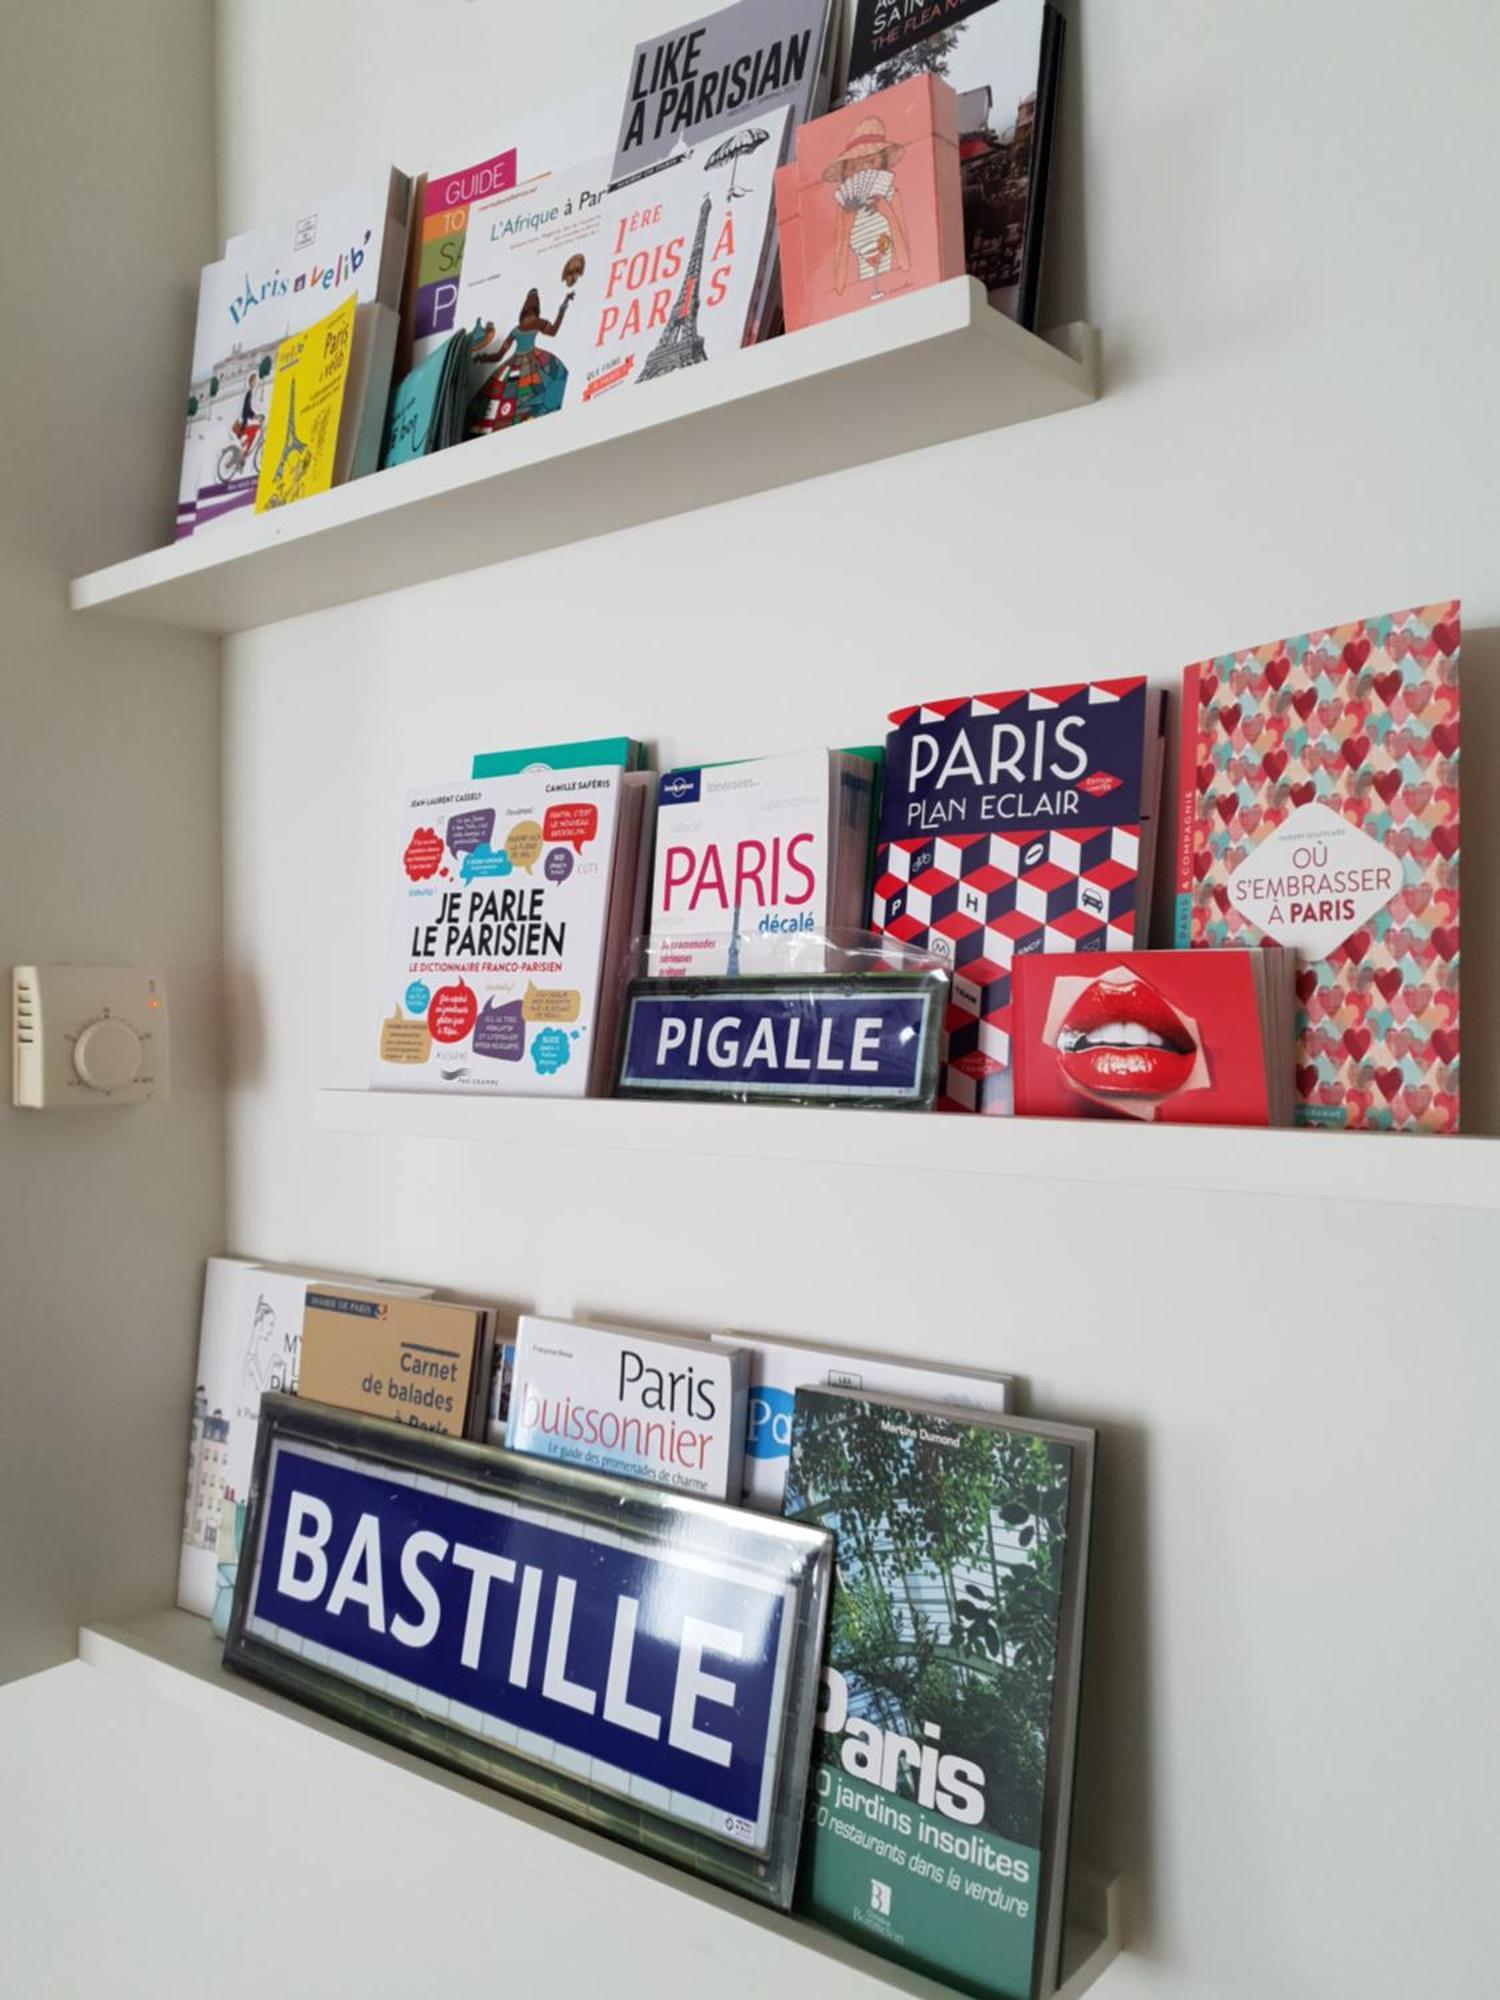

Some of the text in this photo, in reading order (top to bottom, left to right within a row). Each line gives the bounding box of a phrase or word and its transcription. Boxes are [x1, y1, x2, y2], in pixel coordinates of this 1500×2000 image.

[631, 28, 707, 101] LIKE
[622, 99, 646, 152] A
[653, 29, 812, 139] PARISIAN
[445, 163, 505, 204] GUIDE
[444, 210, 466, 232] TO
[490, 207, 558, 241] L'Afrique
[564, 199, 572, 215] à
[605, 211, 735, 299] FOIS À
[596, 265, 732, 347] PARIS
[908, 715, 1088, 793] PARIS
[545, 782, 576, 793] CAMILLE
[907, 790, 1080, 830] PLAN ECLAIR
[663, 833, 816, 912] PARIS
[1292, 841, 1328, 869] OÙ
[966, 892, 978, 913] H
[1236, 867, 1392, 901] S'EMBRASSER
[435, 888, 544, 925] JE PARLE
[758, 912, 815, 933] décalé
[1268, 899, 1355, 924] À PARIS
[411, 921, 566, 957] LE PARISIEN
[408, 961, 563, 973] LE DICTIONNAIRE FRANCO-PARISIEN
[656, 1016, 883, 1072] PIGALLE
[400, 1352, 458, 1382] Carnet
[619, 1350, 716, 1421] Paris
[362, 1373, 453, 1413] de balades
[520, 1382, 714, 1470] buissonnier
[548, 1442, 709, 1491] Le guide des promenades de charme
[277, 1490, 744, 1768] BASTILLE
[835, 1777, 912, 1836] jardins
[918, 1814, 1030, 1883] insolites
[828, 1815, 906, 1866] restaurants
[908, 1854, 944, 1883] dans
[947, 1866, 962, 1892] la
[964, 1879, 1029, 1918] verdure
